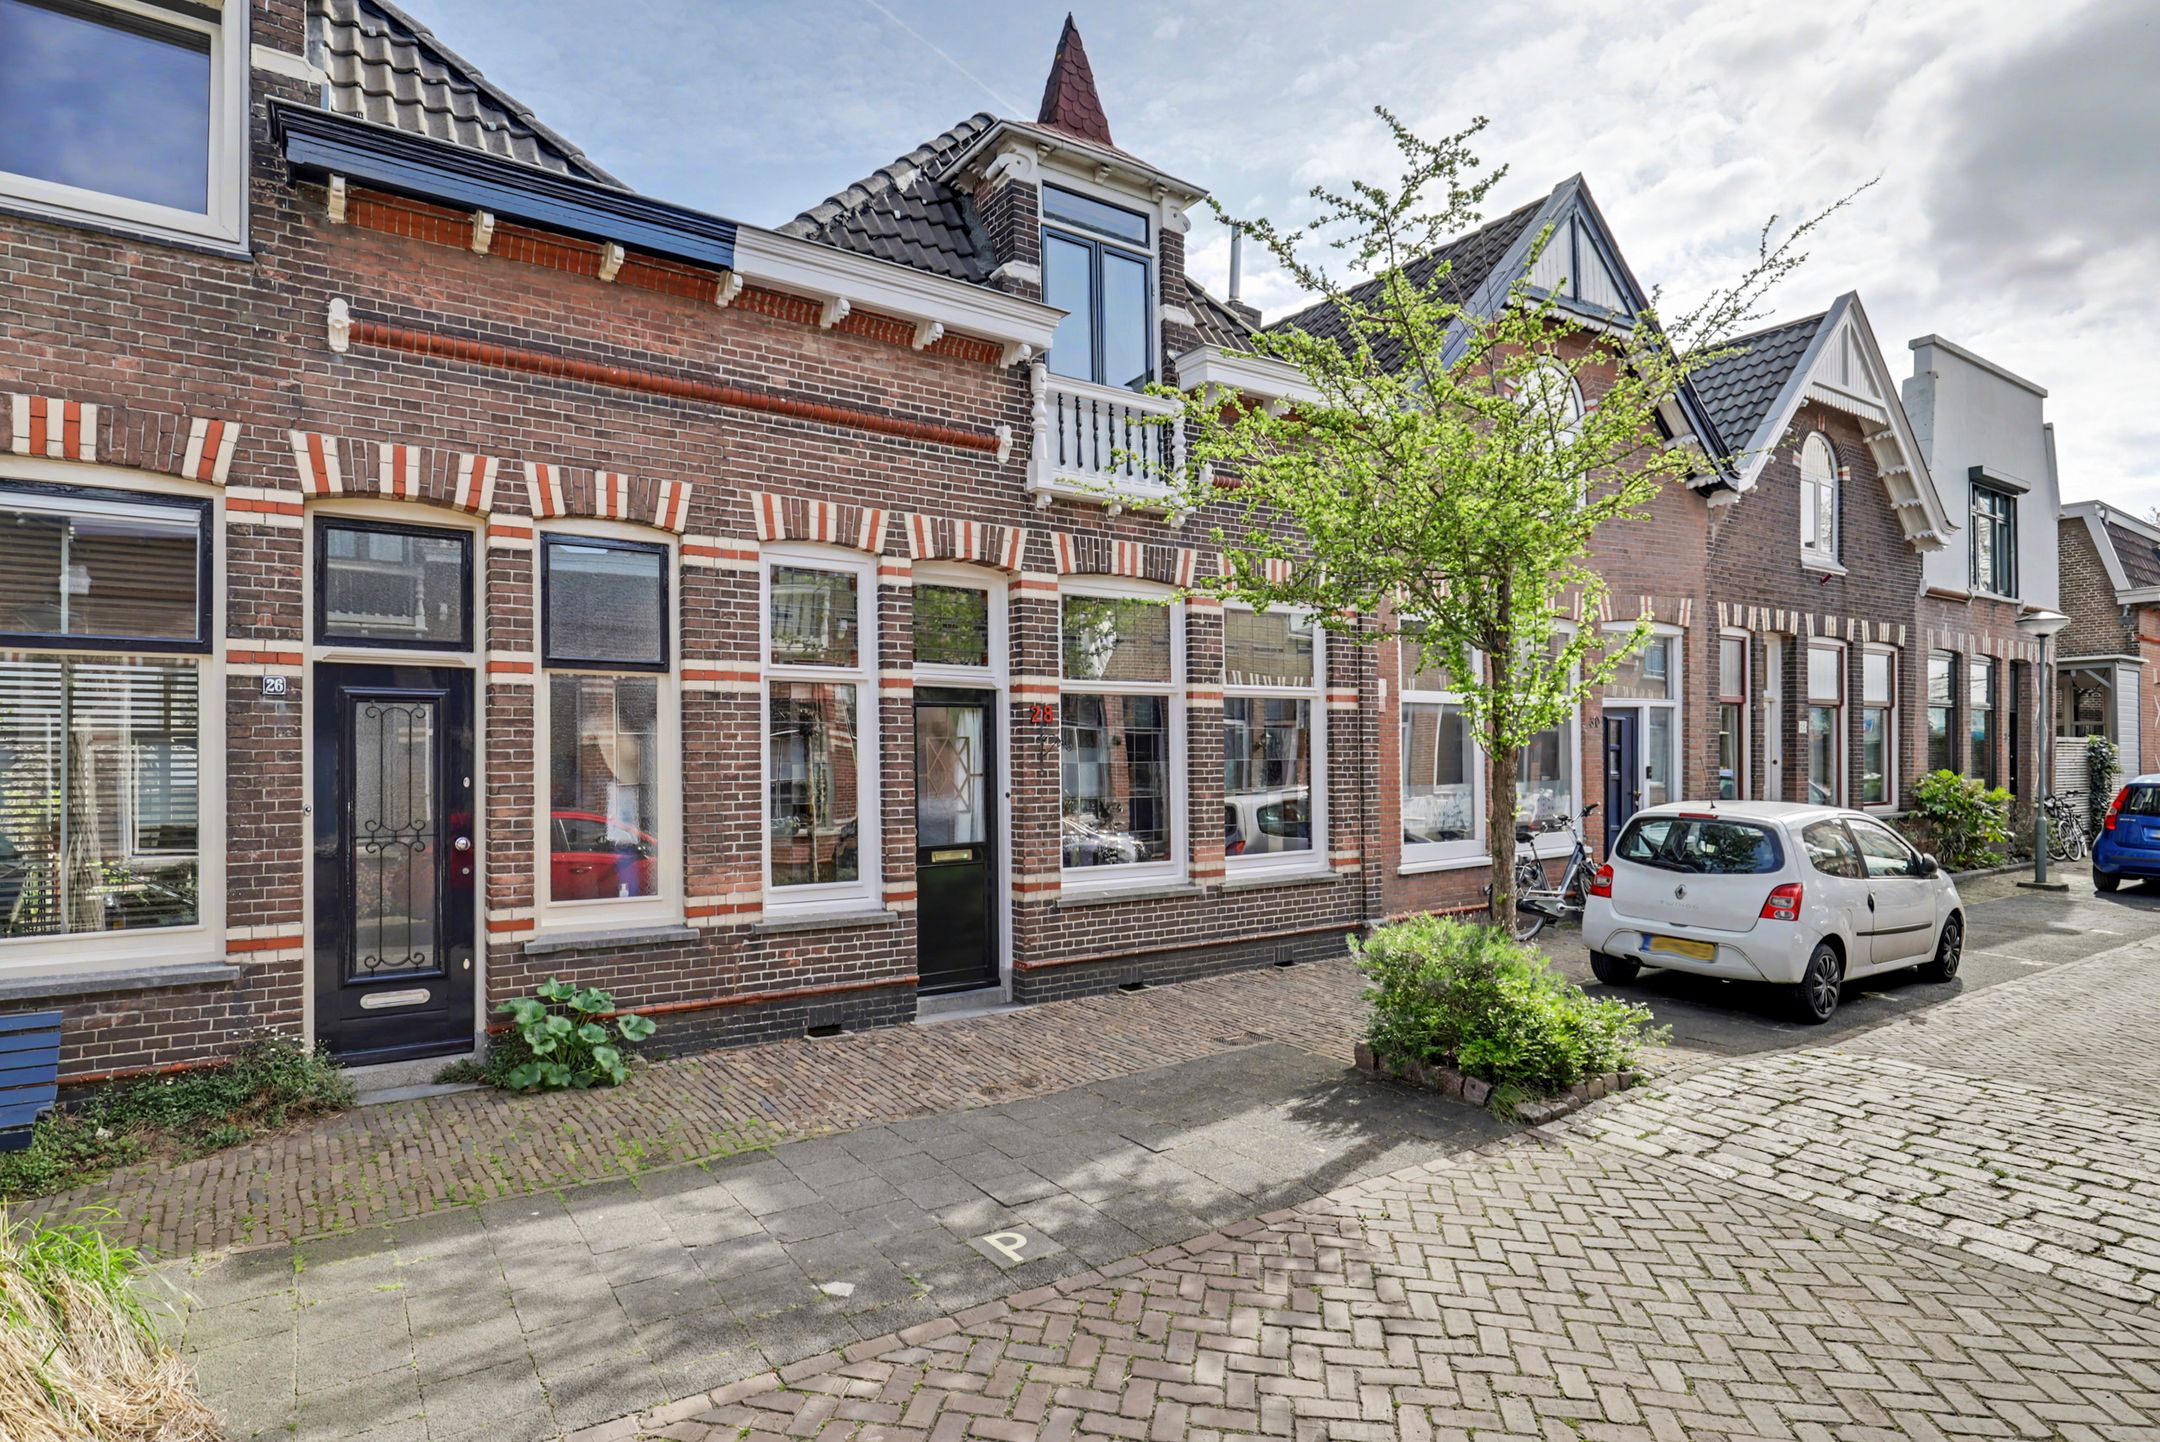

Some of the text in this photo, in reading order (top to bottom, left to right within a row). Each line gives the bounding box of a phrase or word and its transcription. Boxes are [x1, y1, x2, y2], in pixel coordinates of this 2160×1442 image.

[266, 679, 284, 692] 26
[1030, 704, 1054, 724] 28
[982, 1232, 1028, 1262] P
